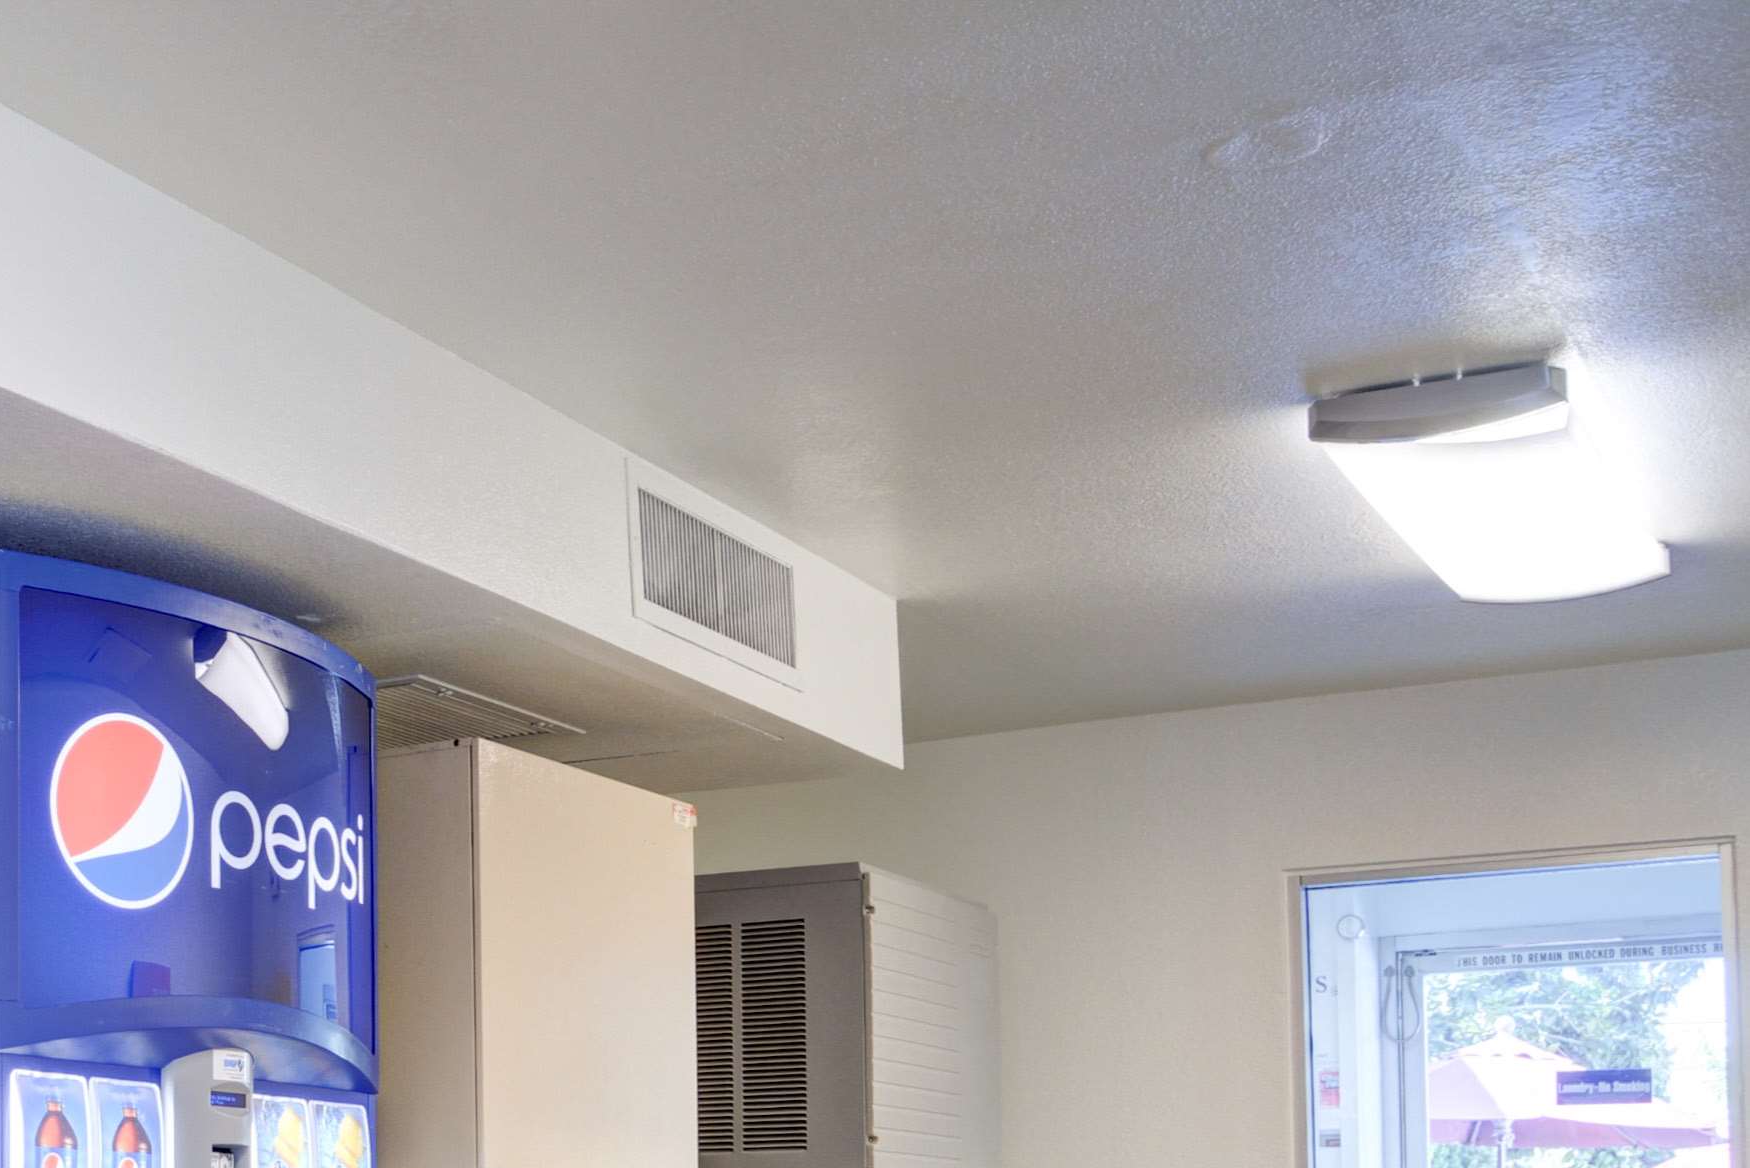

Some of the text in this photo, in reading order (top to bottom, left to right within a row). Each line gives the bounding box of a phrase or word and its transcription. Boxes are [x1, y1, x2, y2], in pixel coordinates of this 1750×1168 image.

[210, 790, 365, 909] pepsi
[1482, 954, 1507, 966] DOOR
[1511, 953, 1524, 965] TO
[1528, 951, 1563, 964] REMAIN
[1568, 948, 1615, 961] UNLOCKED
[1620, 946, 1655, 958] DURING
[1661, 943, 1707, 957] BUSINESS
[1613, 1080, 1650, 1094] Smoking
